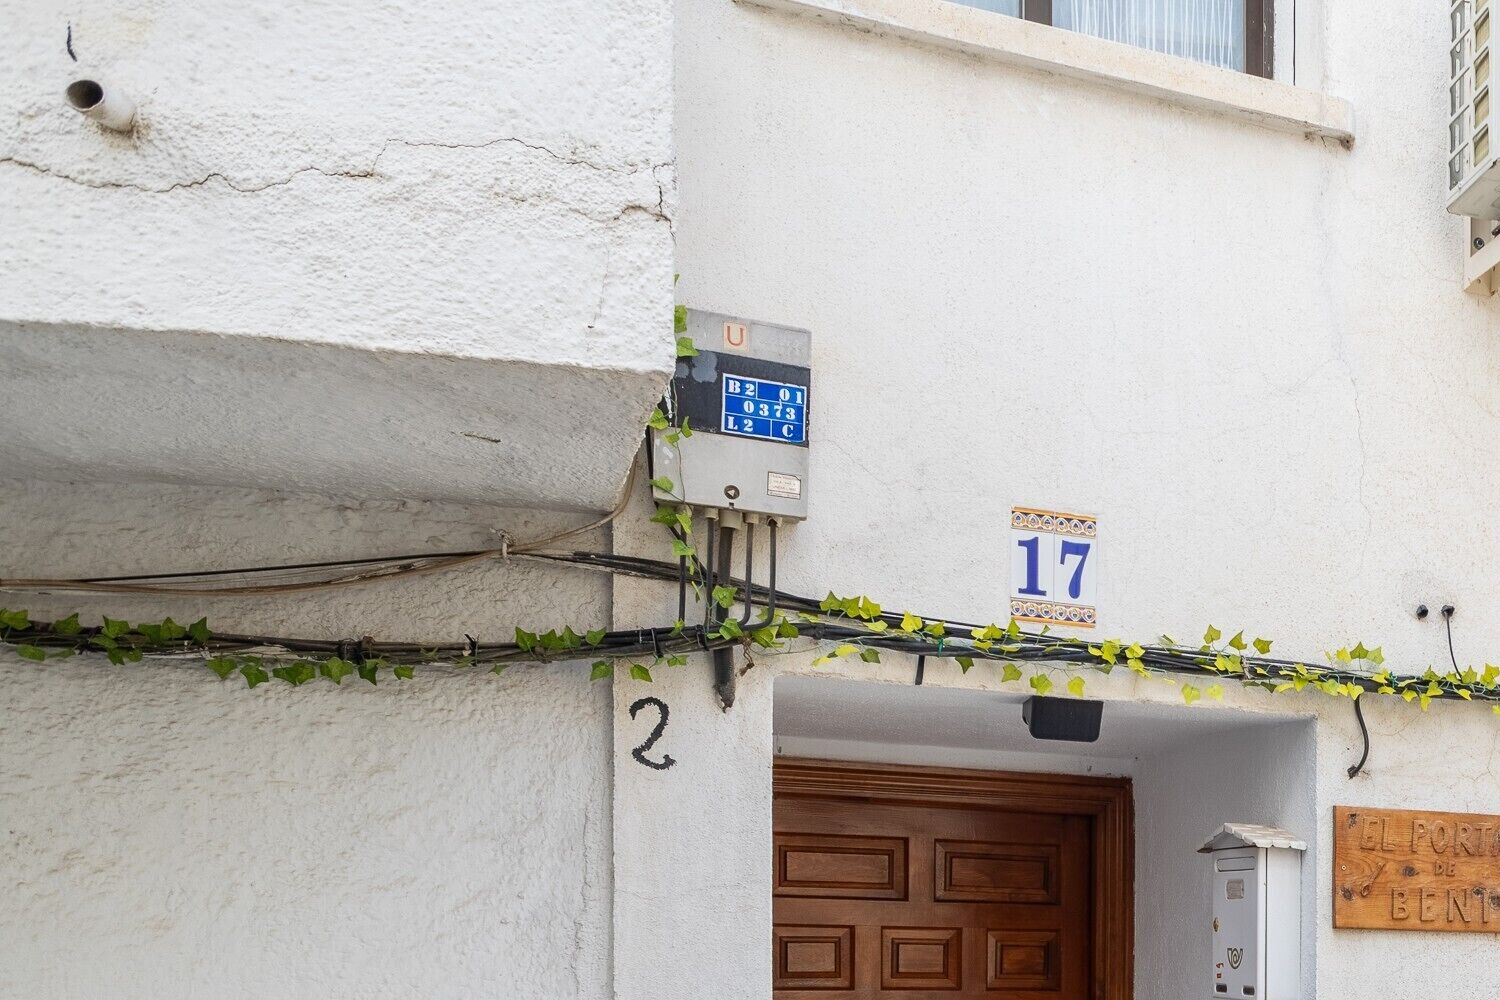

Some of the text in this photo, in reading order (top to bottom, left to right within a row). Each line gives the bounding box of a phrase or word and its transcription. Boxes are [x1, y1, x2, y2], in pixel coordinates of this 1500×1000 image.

[726, 324, 744, 347] U
[743, 401, 796, 420] 0373
[781, 425, 794, 438] C
[1017, 536, 1091, 600] 17
[629, 696, 677, 770] 2
[1359, 815, 1396, 852] EL
[1433, 859, 1456, 877] DE
